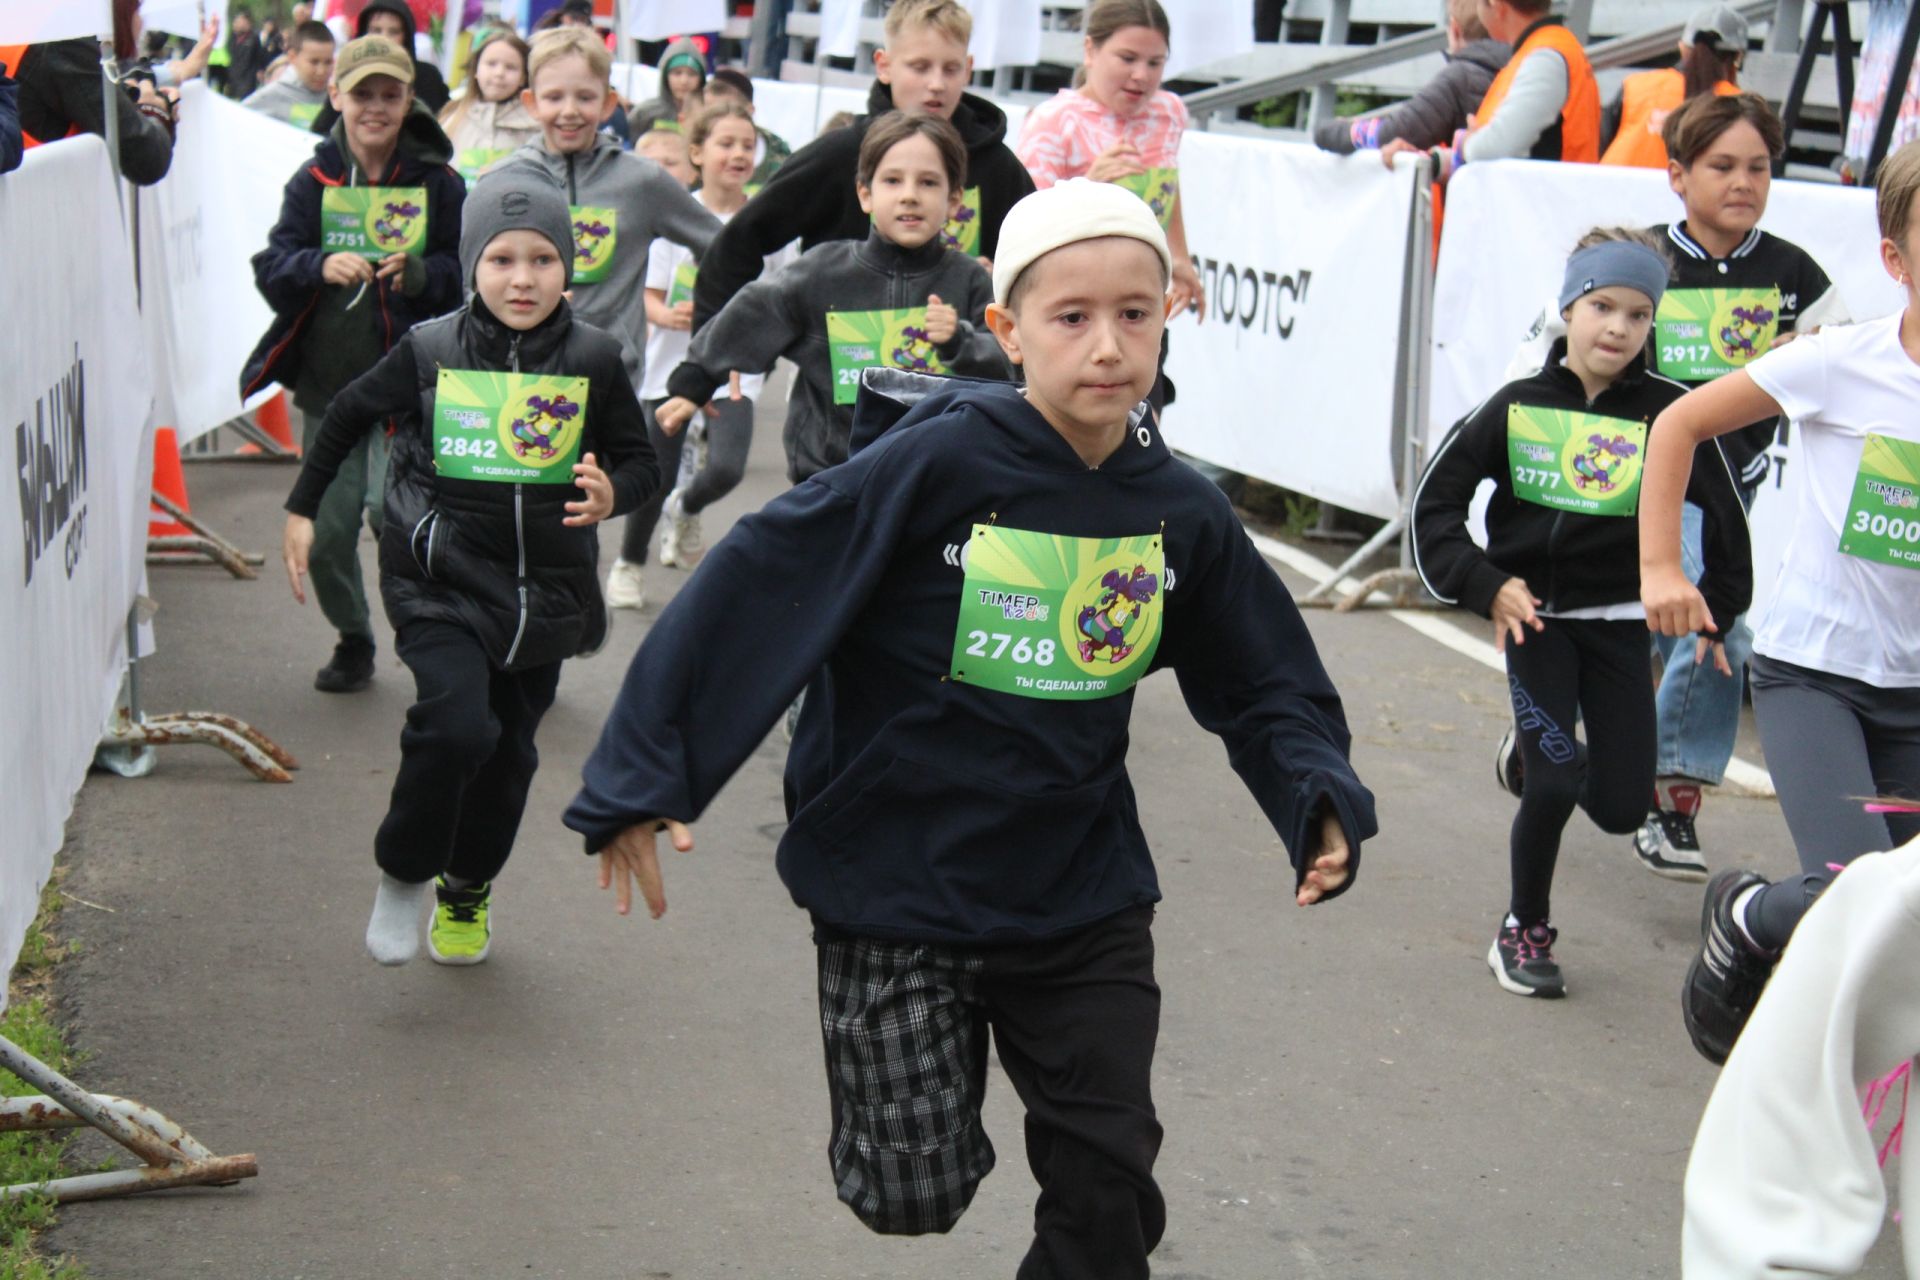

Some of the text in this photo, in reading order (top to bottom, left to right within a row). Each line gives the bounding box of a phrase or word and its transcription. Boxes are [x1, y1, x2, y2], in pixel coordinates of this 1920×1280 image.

[327, 232, 365, 247] 2751
[1662, 346, 1710, 362] 2917
[838, 368, 861, 385] 29
[440, 437, 497, 459] 2842
[472, 465, 485, 474] ТЫ
[485, 467, 521, 476] СДЕЛАЛ
[1515, 466, 1560, 489] 2777
[1866, 480, 1912, 499] TIMER
[1852, 510, 1920, 543] 3000
[1889, 548, 1920, 563] ТЫ СДЕ
[978, 589, 1038, 609] TIMER
[966, 630, 1055, 667] 2768
[1015, 676, 1107, 691] ТЫ СДЕЛАЛ ЭТО!
